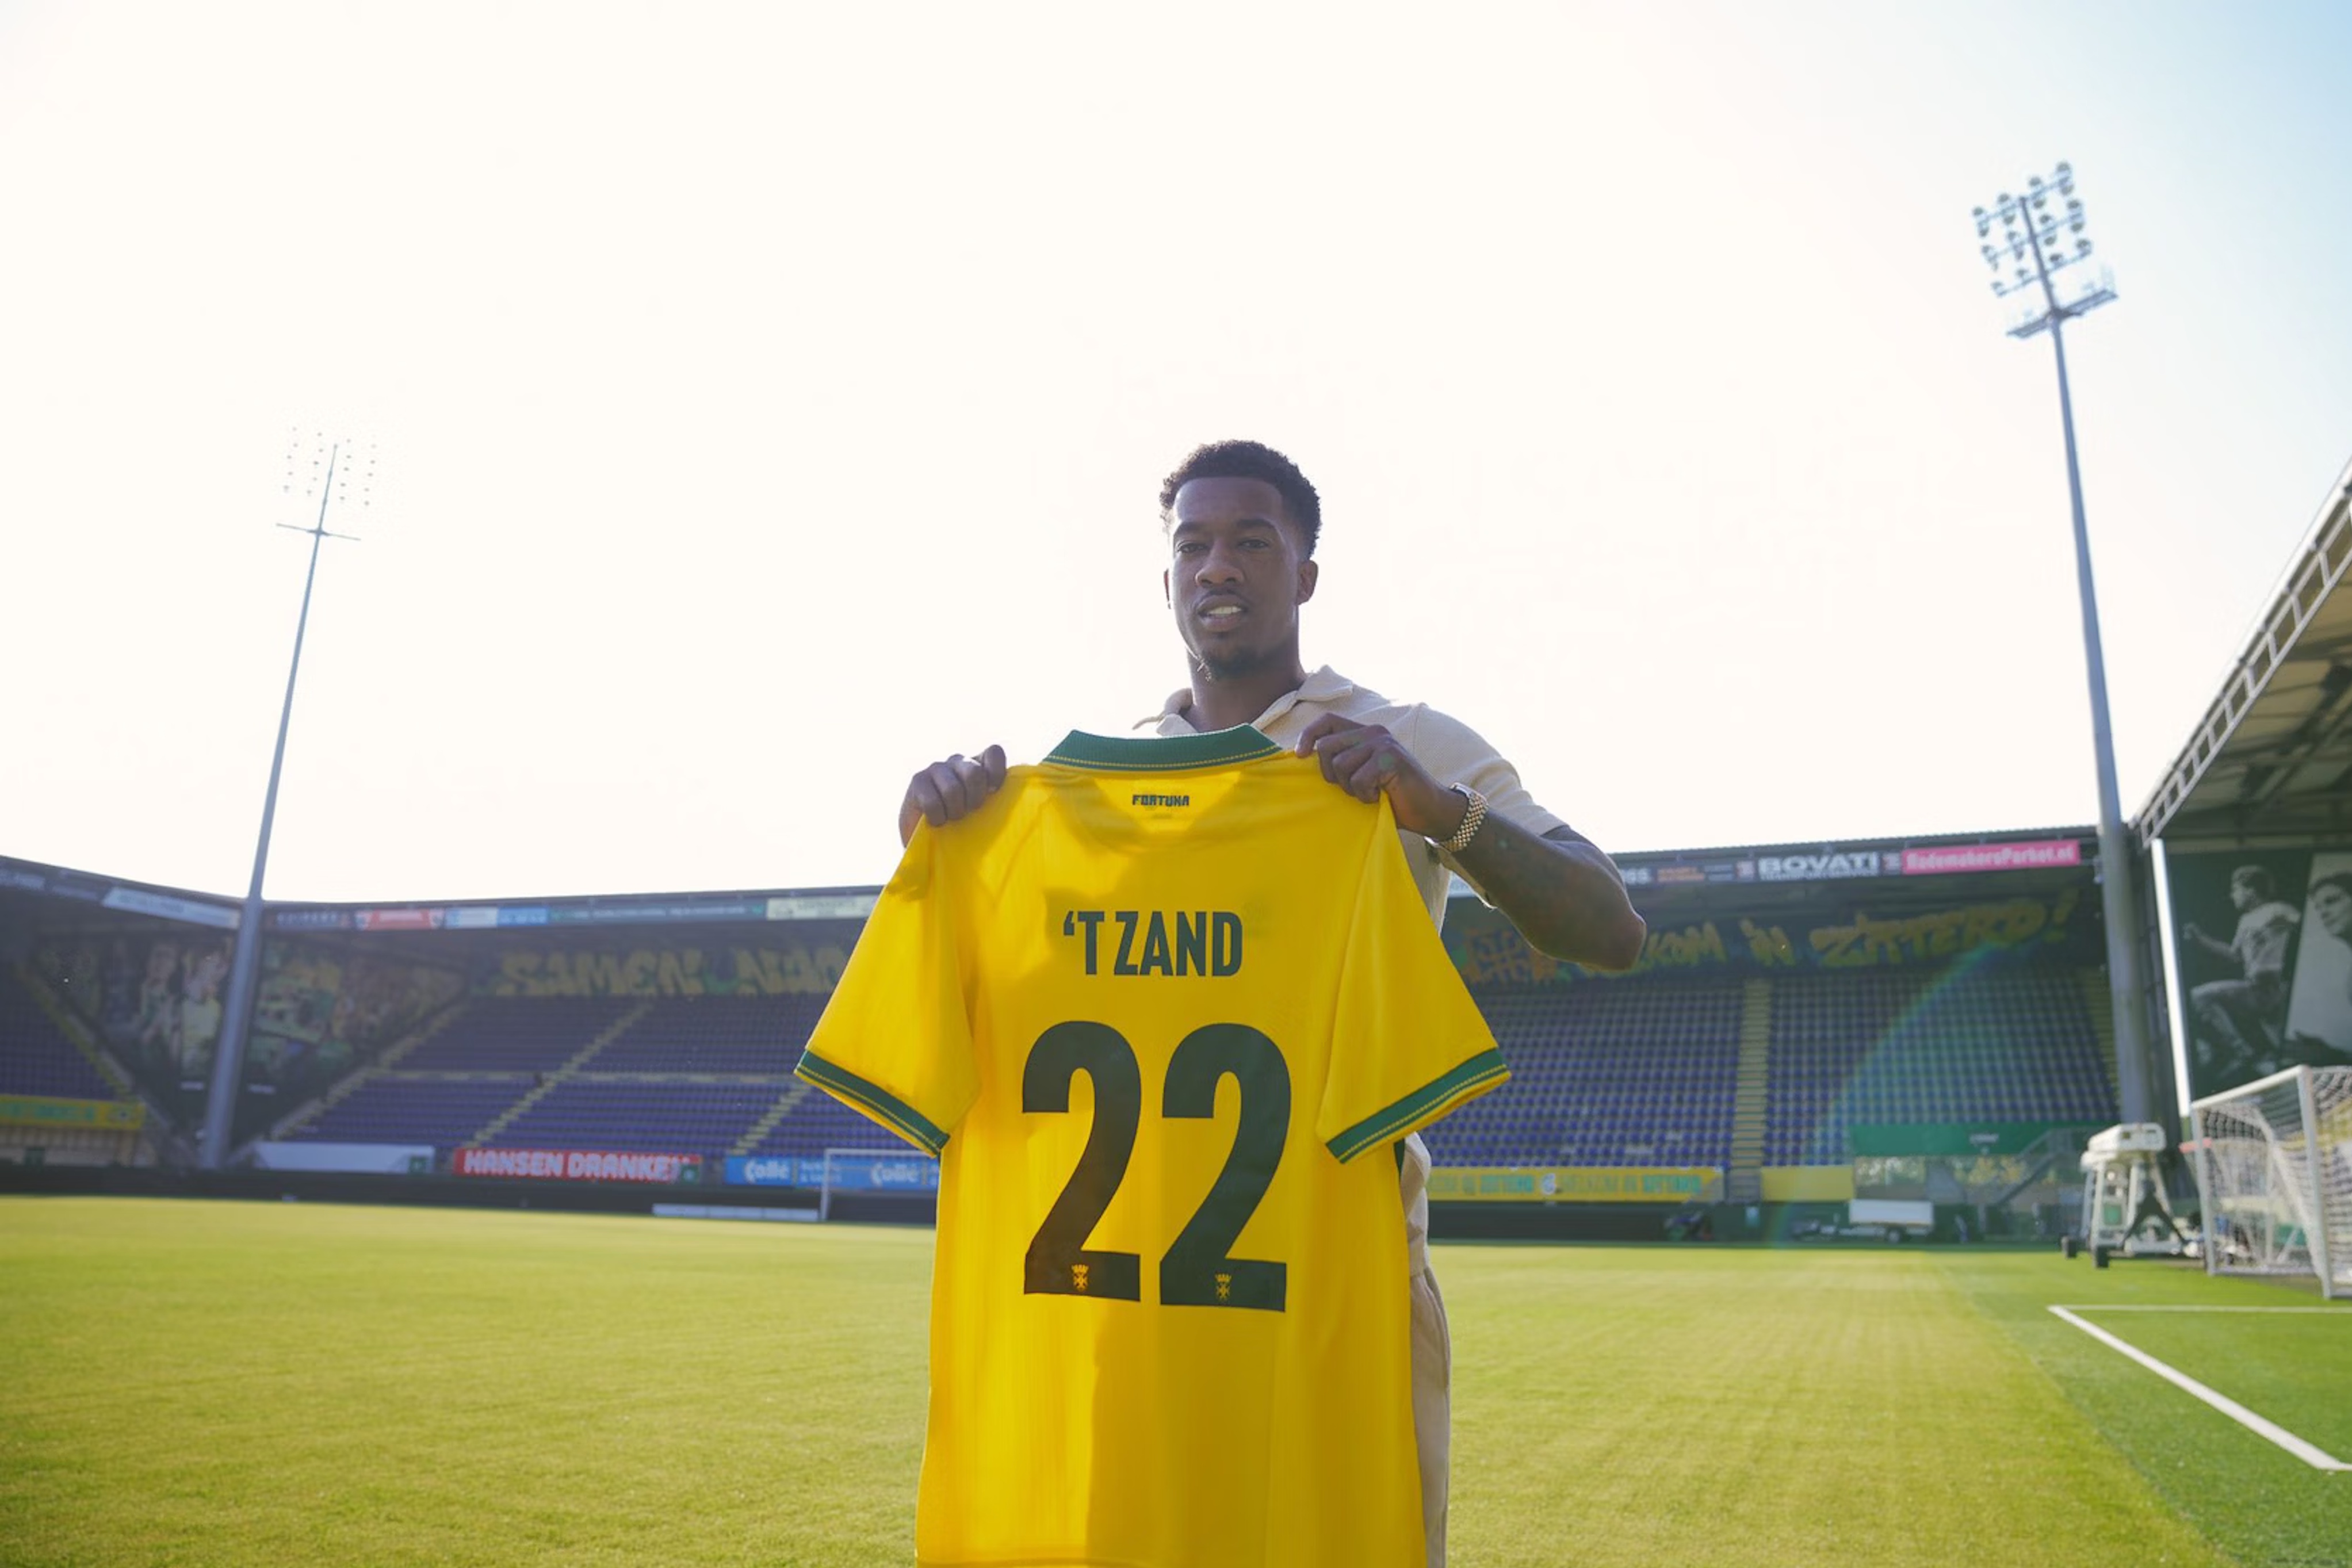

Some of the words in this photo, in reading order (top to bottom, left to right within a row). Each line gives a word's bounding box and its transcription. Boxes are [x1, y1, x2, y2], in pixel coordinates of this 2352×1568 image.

[1132, 794, 1190, 807] FORTUNA
[1758, 851, 1878, 875] BOVATI
[1114, 911, 1242, 977] ZAND
[495, 948, 706, 996] SAMEN
[463, 1150, 563, 1176] HANSEN
[1022, 1020, 1292, 1313] 22
